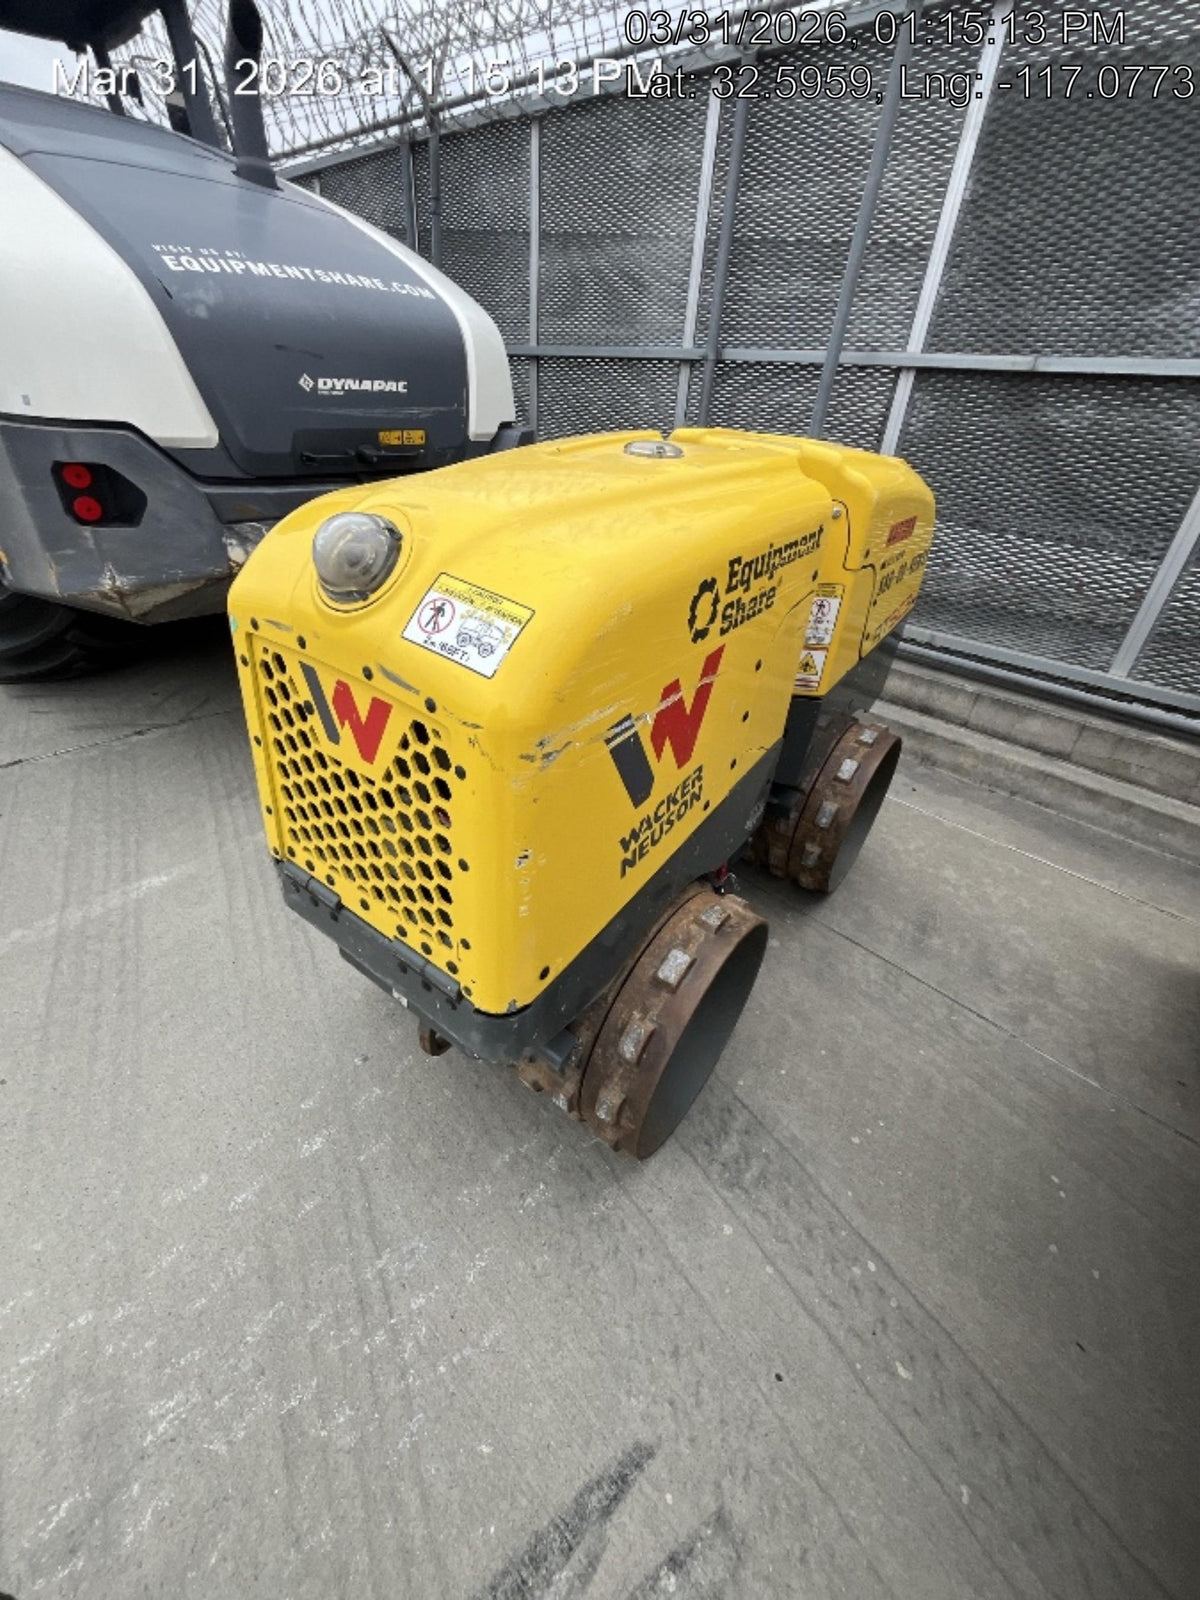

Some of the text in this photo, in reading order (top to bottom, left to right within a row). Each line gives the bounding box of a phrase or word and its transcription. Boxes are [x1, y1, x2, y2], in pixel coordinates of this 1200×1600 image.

[161, 255, 436, 299] EQUIPMENTSHARE.COM
[317, 377, 408, 393] DYNAPAC
[725, 524, 824, 595] Equipment
[719, 585, 778, 637] Share
[618, 764, 704, 854] WACKER
[619, 783, 704, 879] NEUSON
